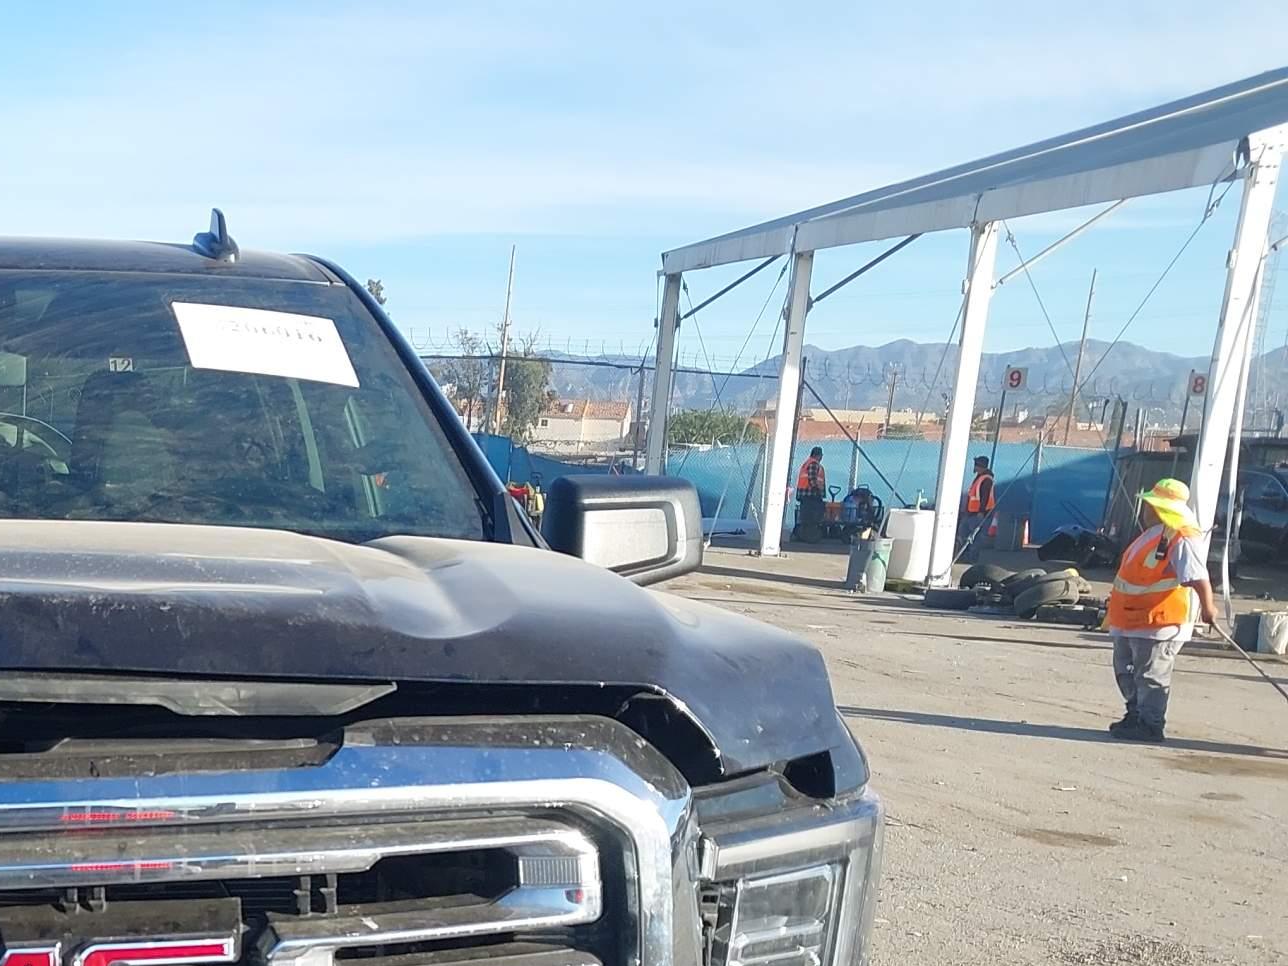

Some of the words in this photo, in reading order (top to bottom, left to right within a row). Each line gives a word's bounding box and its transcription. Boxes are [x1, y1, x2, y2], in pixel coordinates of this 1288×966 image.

[110, 358, 131, 371] 12
[1009, 369, 1021, 388] 9
[1192, 375, 1206, 394] 8
